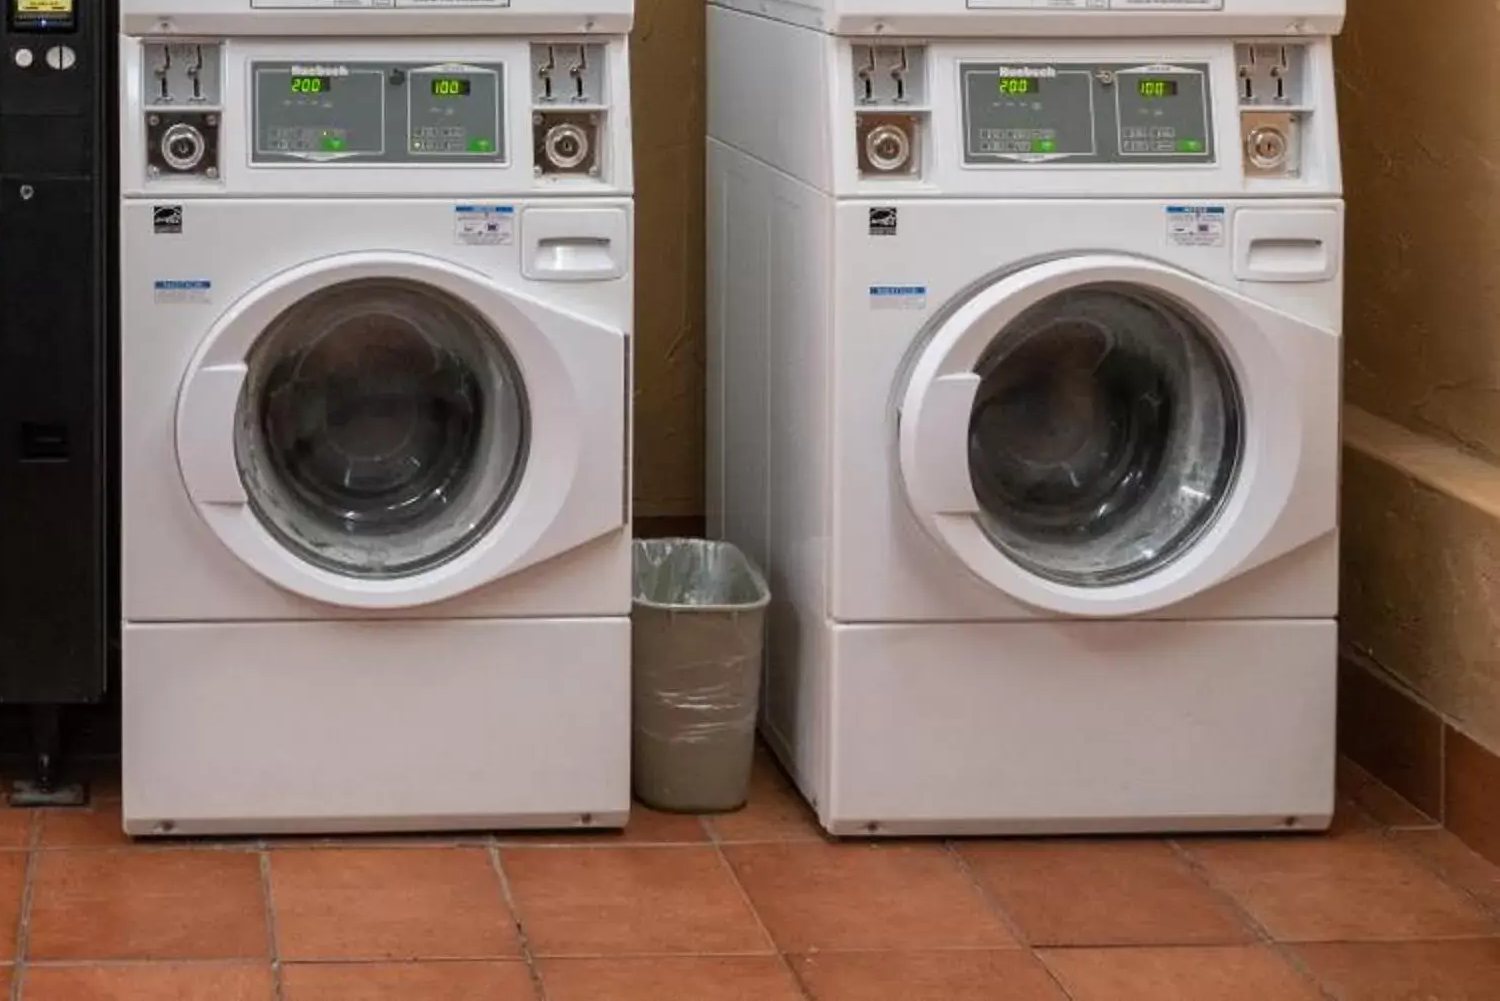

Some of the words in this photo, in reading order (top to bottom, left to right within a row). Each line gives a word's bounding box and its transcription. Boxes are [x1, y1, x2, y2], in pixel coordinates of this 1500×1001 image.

[291, 78, 322, 93] 200
[435, 81, 459, 94] 100
[999, 78, 1028, 94] 200
